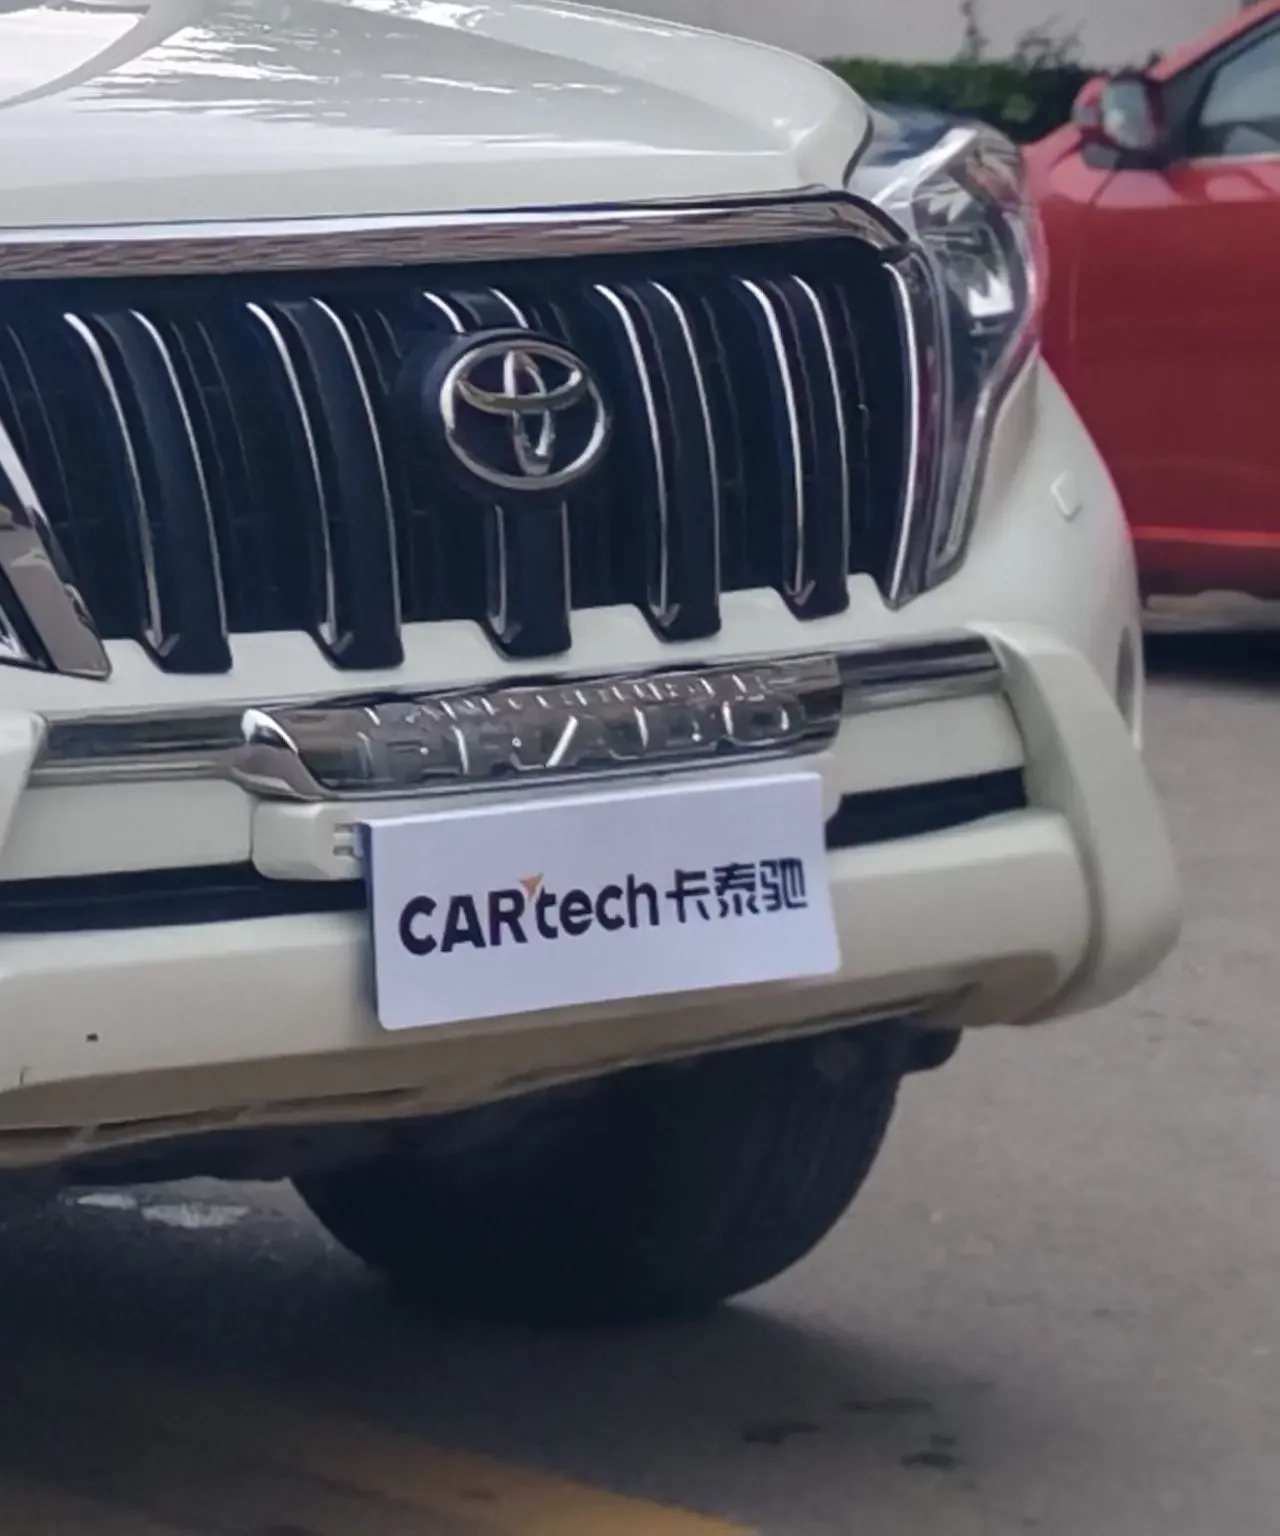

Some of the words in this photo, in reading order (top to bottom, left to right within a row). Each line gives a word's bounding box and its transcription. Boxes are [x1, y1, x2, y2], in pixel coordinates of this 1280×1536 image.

[398, 873, 660, 956] CARtech
[665, 857, 809, 923] 卡泰驰
